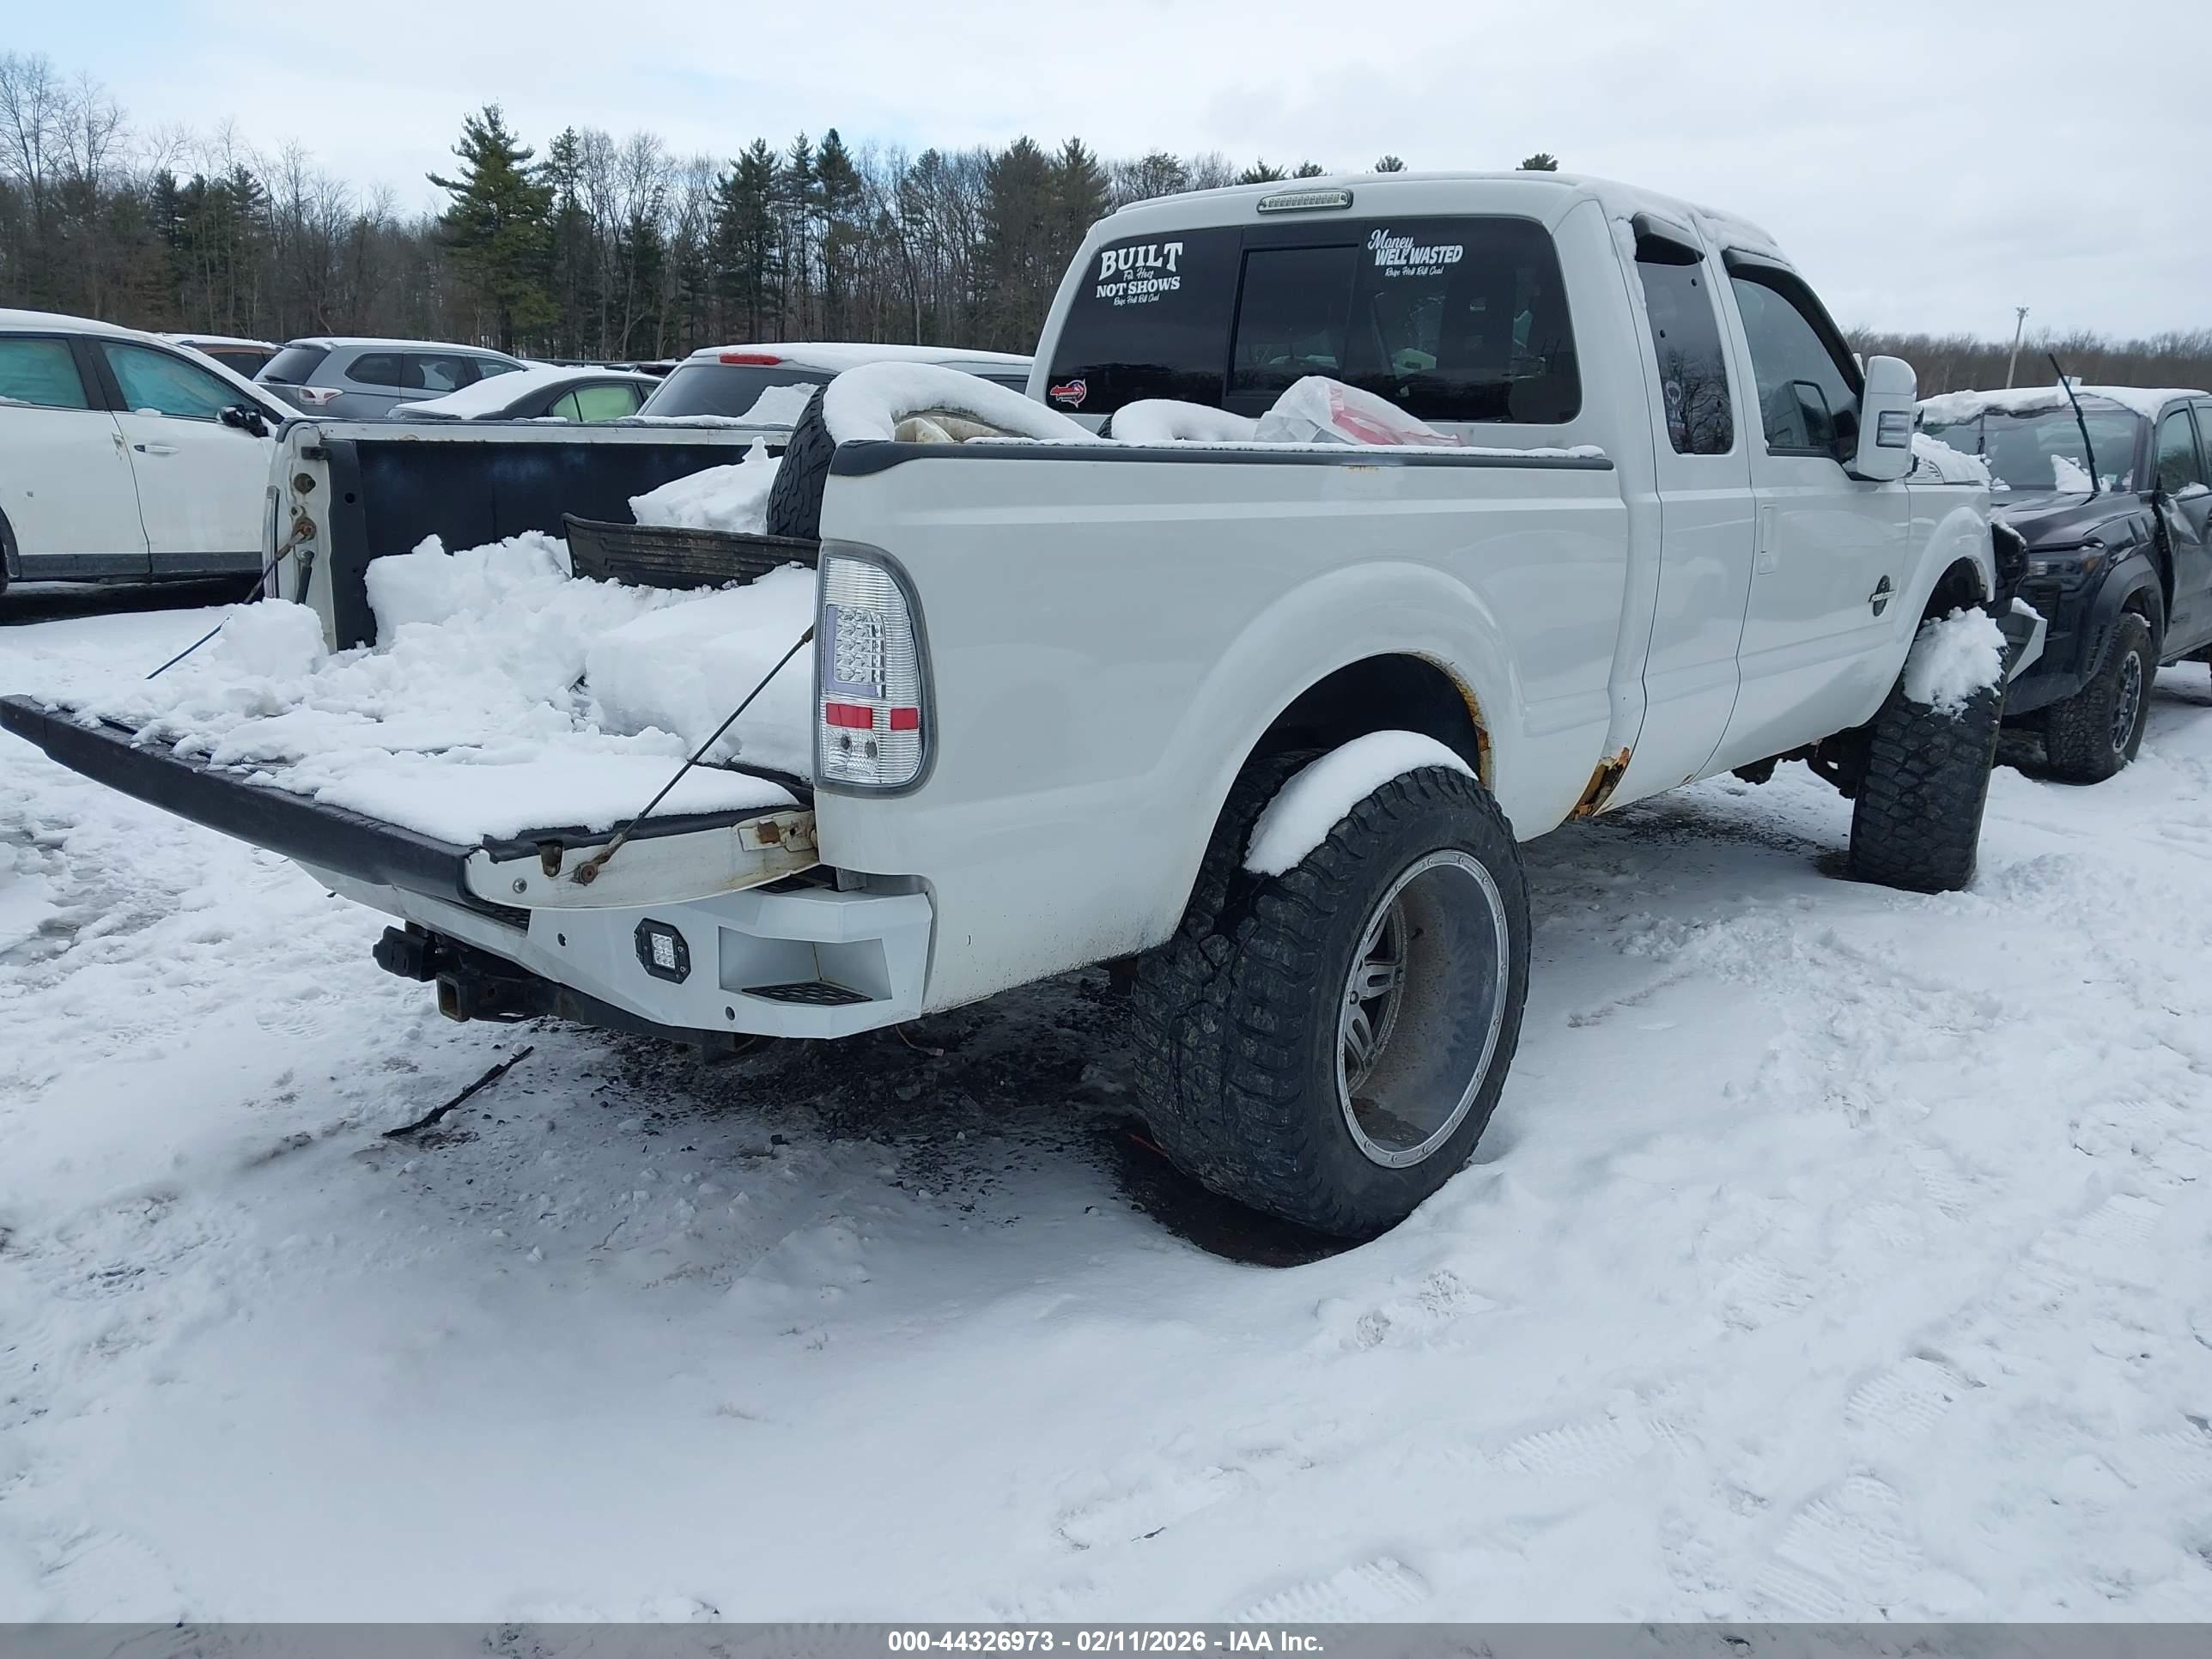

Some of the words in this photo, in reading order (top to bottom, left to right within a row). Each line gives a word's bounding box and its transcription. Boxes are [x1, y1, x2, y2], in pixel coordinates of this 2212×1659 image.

[1368, 228, 1414, 256] Money
[1099, 242, 1183, 282] BUILT
[1375, 248, 1407, 265] WELL
[1409, 245, 1463, 264] WASTED
[1096, 283, 1127, 298] NOT
[1127, 276, 1181, 295] SHOWS
